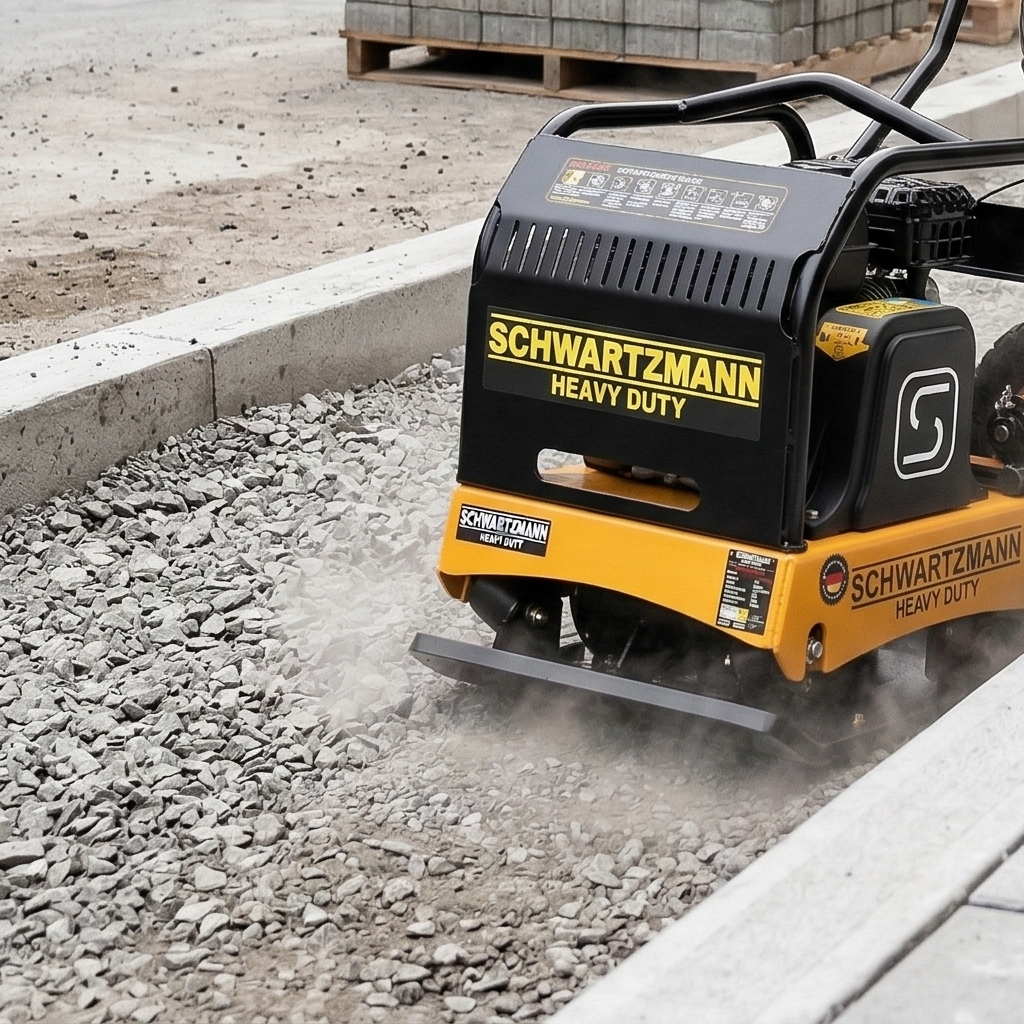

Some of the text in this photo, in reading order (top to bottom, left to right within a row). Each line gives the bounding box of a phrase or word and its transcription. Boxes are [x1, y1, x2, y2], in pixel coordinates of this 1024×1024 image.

[488, 321, 761, 401] SCHWARTZMANN
[551, 373, 686, 419] HEAVY DUTY
[851, 531, 1021, 603] SCHWARTZMANN
[896, 578, 980, 619] HEAVY DUTY
